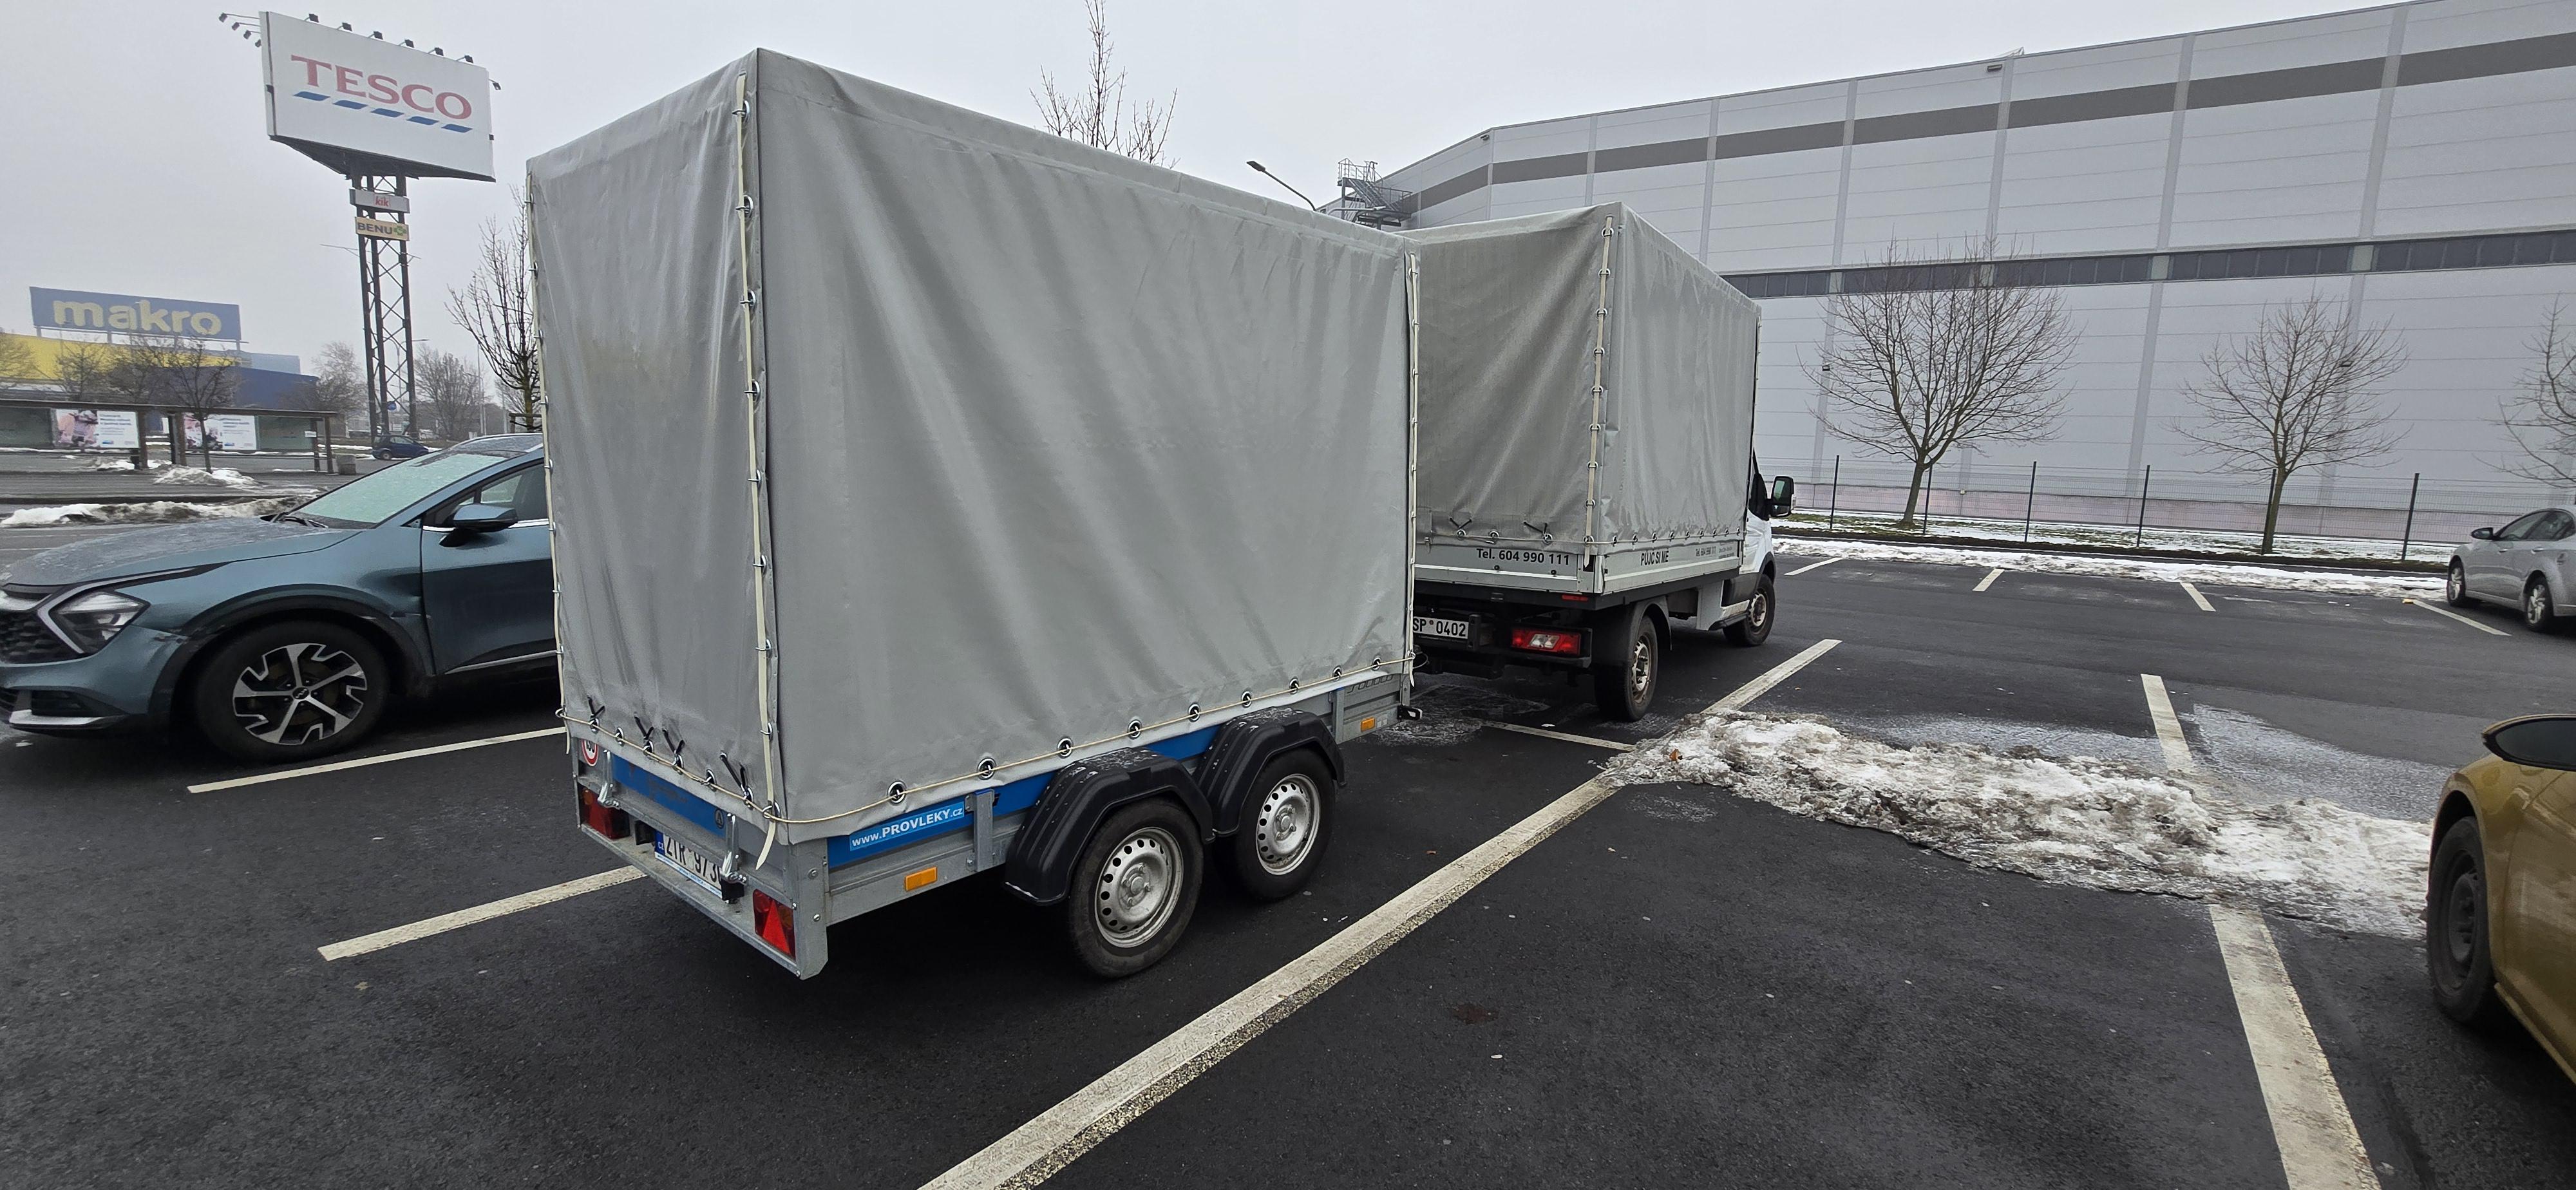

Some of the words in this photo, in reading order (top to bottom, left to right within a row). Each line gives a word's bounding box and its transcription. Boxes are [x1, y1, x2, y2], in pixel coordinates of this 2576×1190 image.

[291, 55, 472, 120] TESCO
[357, 222, 393, 234] BENU
[52, 299, 222, 335] makro
[1476, 548, 1495, 560] Tel.
[1499, 550, 1520, 562] 604
[1523, 552, 1545, 563] 990
[1549, 553, 1569, 565] 111
[1435, 620, 1466, 636] 0402
[851, 808, 963, 847] www.PROVLEKY.cz
